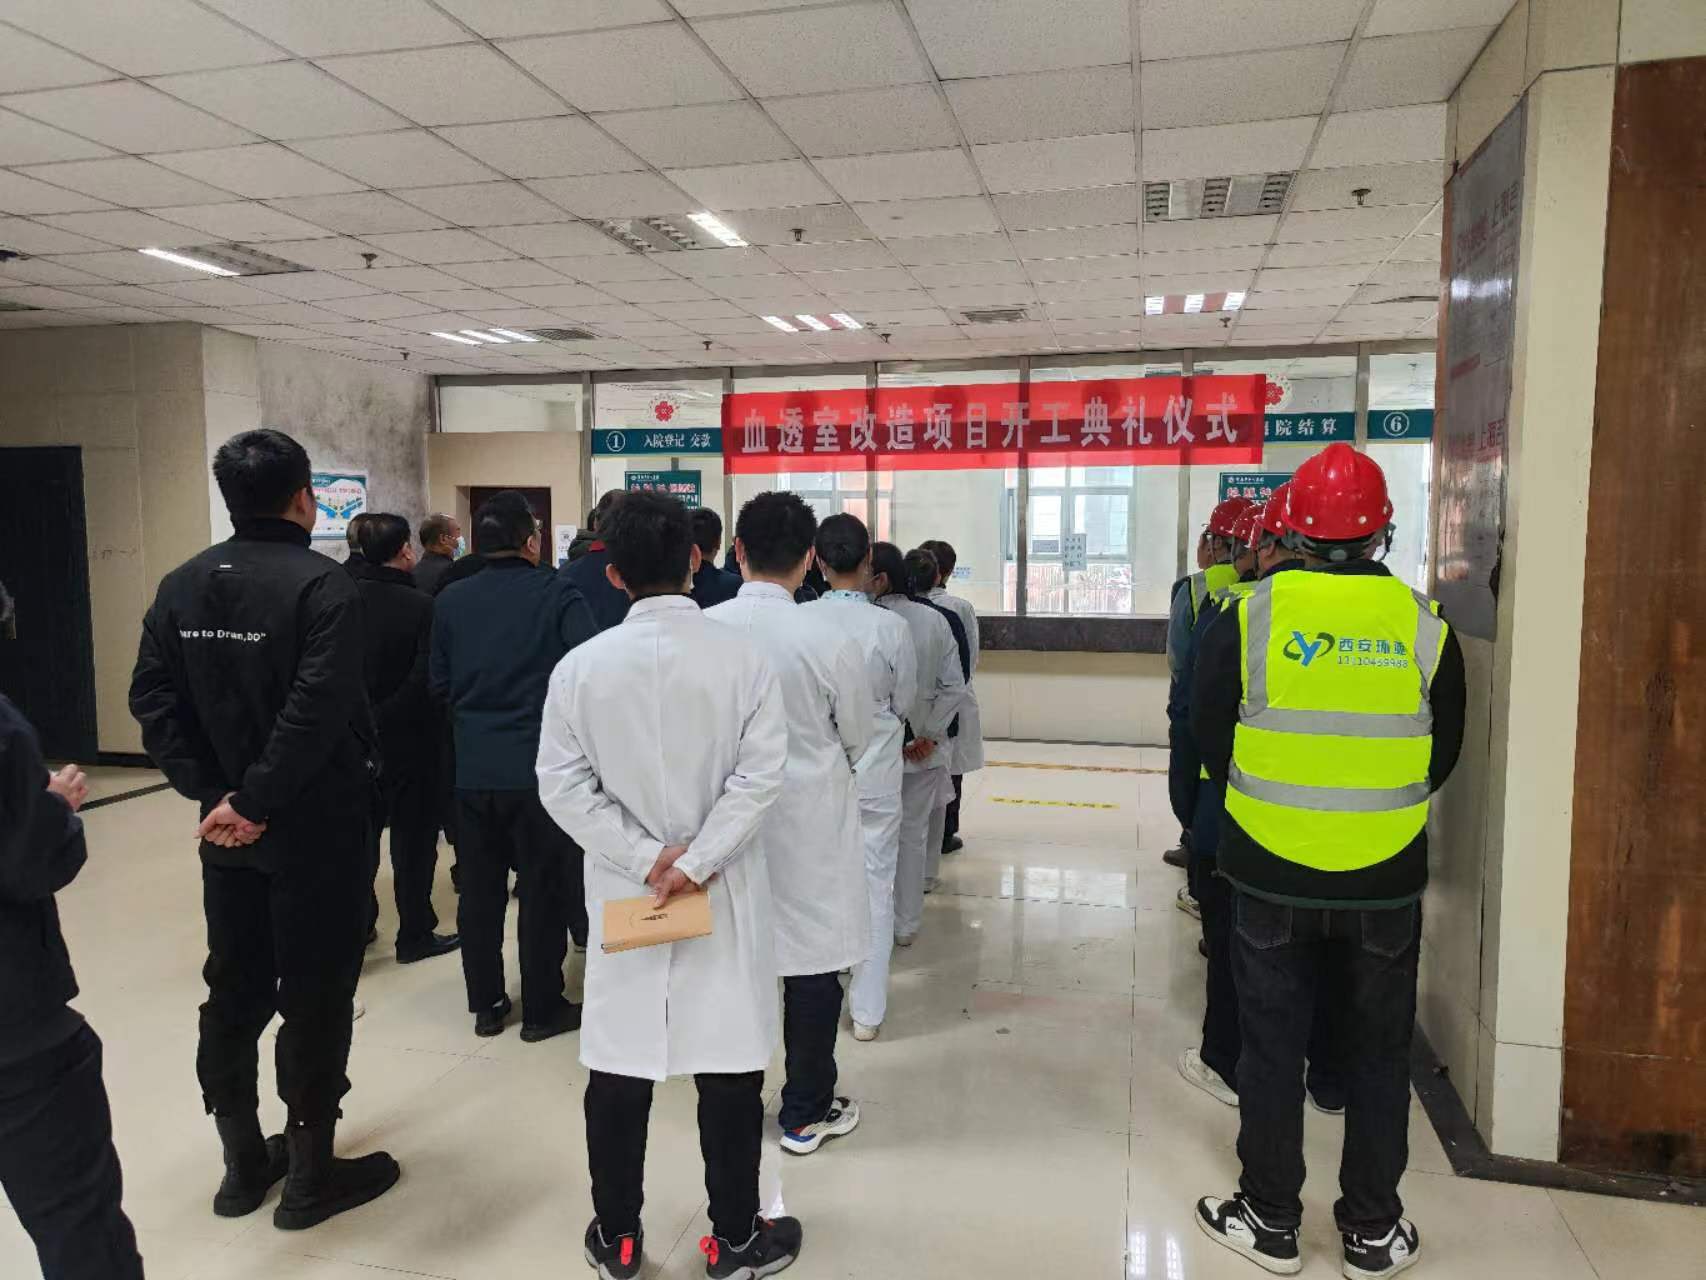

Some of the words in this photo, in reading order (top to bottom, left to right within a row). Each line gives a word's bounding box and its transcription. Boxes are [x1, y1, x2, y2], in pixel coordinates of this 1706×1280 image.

[741, 392, 1239, 454] 血透室改造项目开工典礼仪式
[202, 629, 215, 638] to
